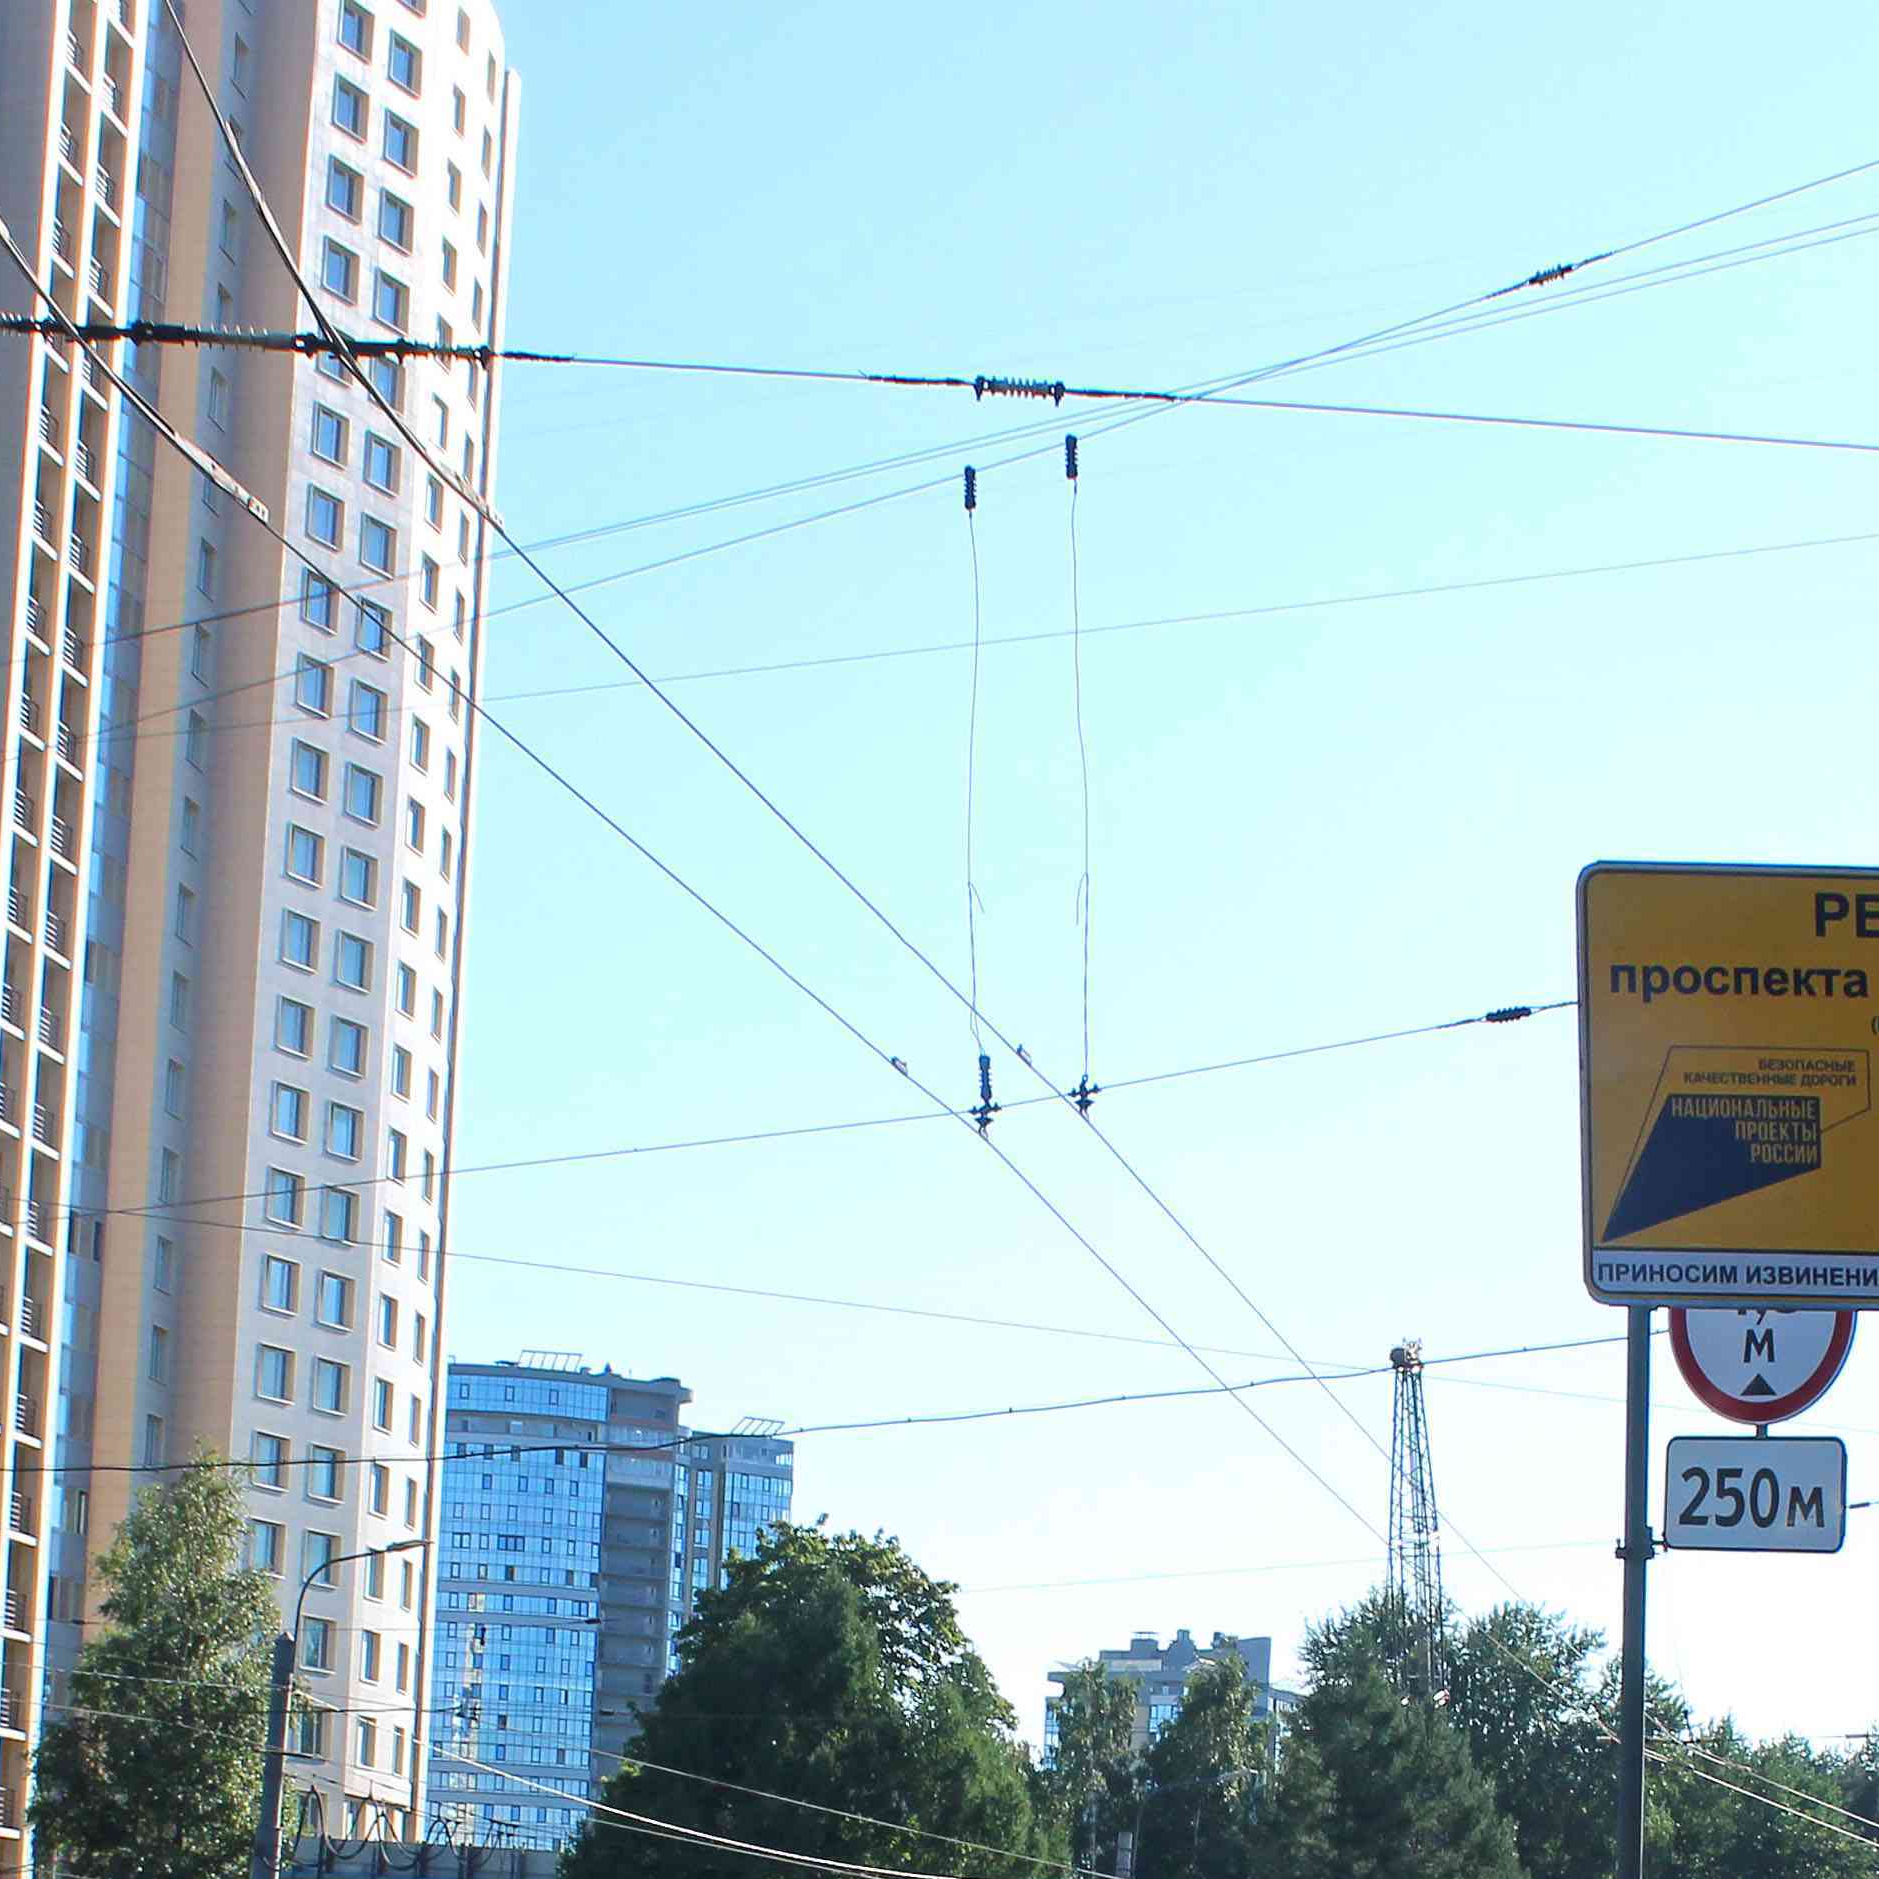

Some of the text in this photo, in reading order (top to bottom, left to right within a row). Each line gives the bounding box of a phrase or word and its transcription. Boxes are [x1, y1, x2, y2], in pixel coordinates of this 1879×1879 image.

[1610, 963, 1868, 1003] проспекта
[1758, 1058, 1856, 1072] БЕЗОПАСНЫЕ
[1684, 1072, 1856, 1088] КАЧЕСТВЕННЫЕ ДОРОГИ
[1671, 1097, 1816, 1120] НАЦИОНАЛЬНЫЕ
[1734, 1120, 1818, 1142] ПРОЕКТЫ
[1750, 1143, 1818, 1165] РОССИИ
[1598, 1262, 1738, 1284] ПРИНОСИМ
